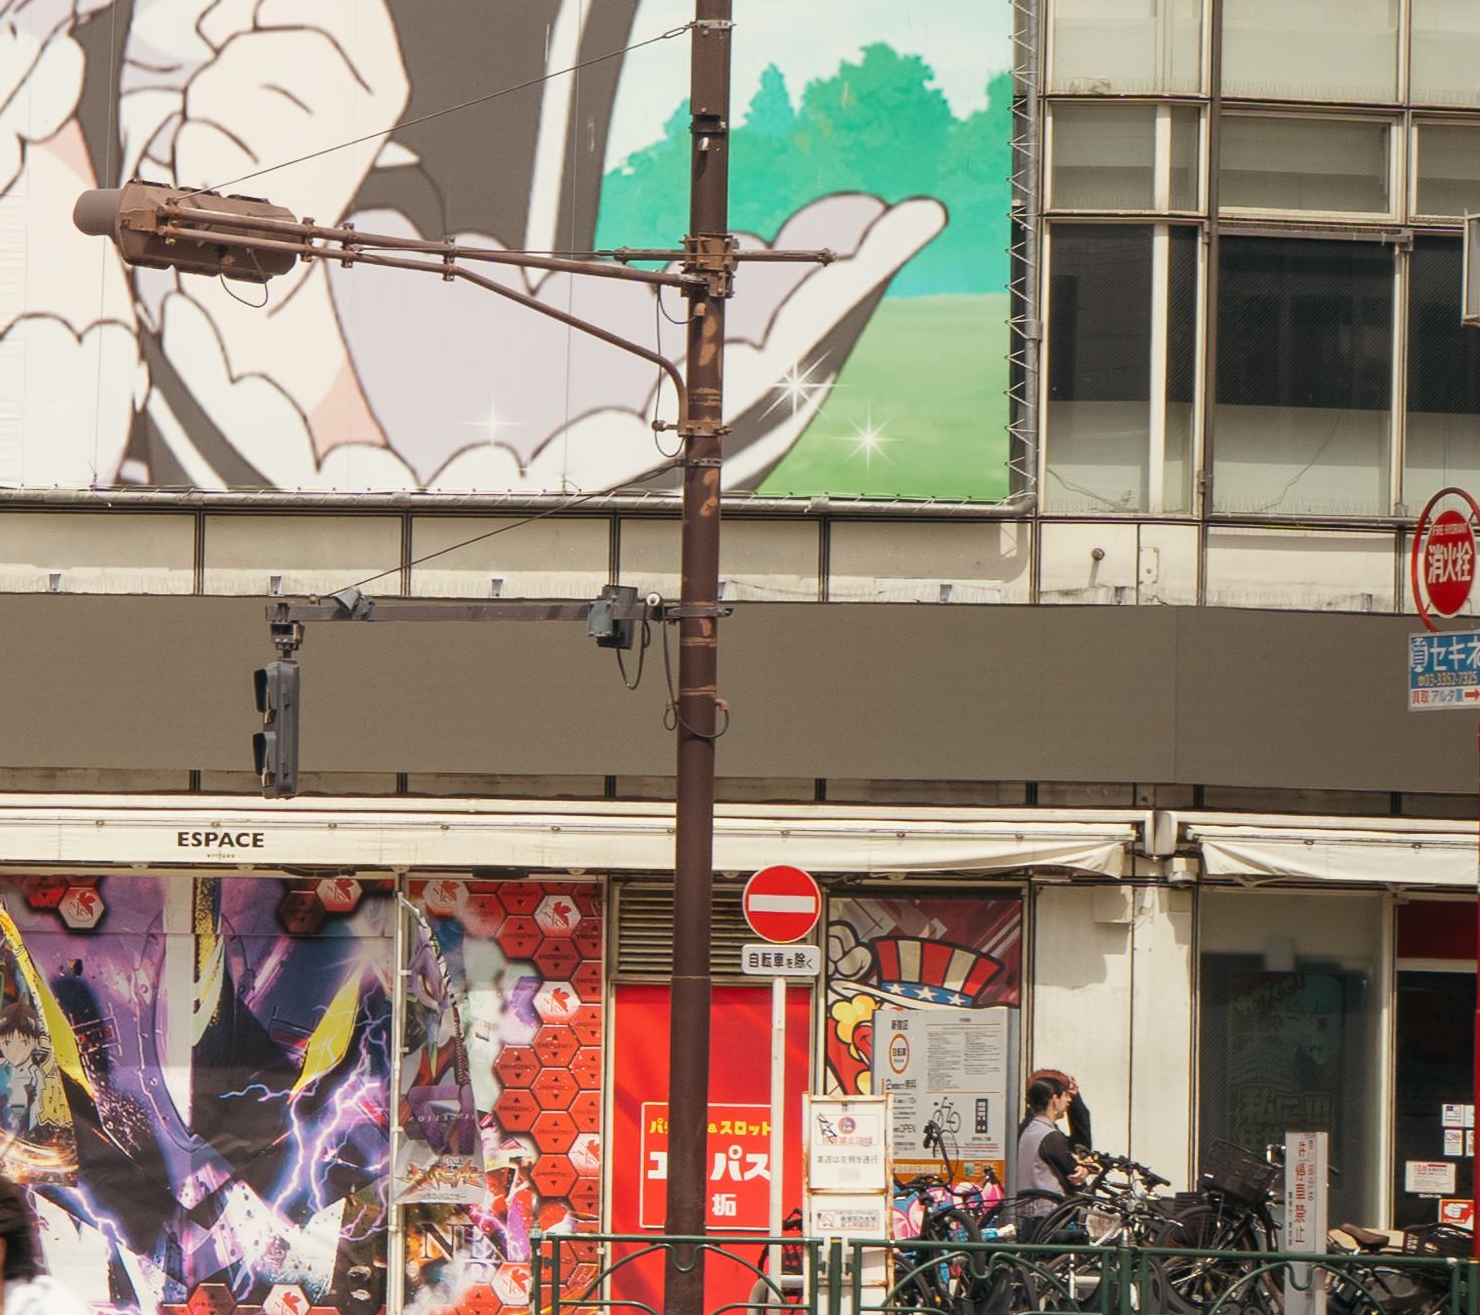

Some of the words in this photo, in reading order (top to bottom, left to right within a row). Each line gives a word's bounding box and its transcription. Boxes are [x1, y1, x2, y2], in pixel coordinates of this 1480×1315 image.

[1428, 541, 1472, 584] 消火栓
[177, 831, 265, 848] ESPACE
[748, 951, 814, 970] 自転車を除く
[647, 1144, 771, 1181] エパス
